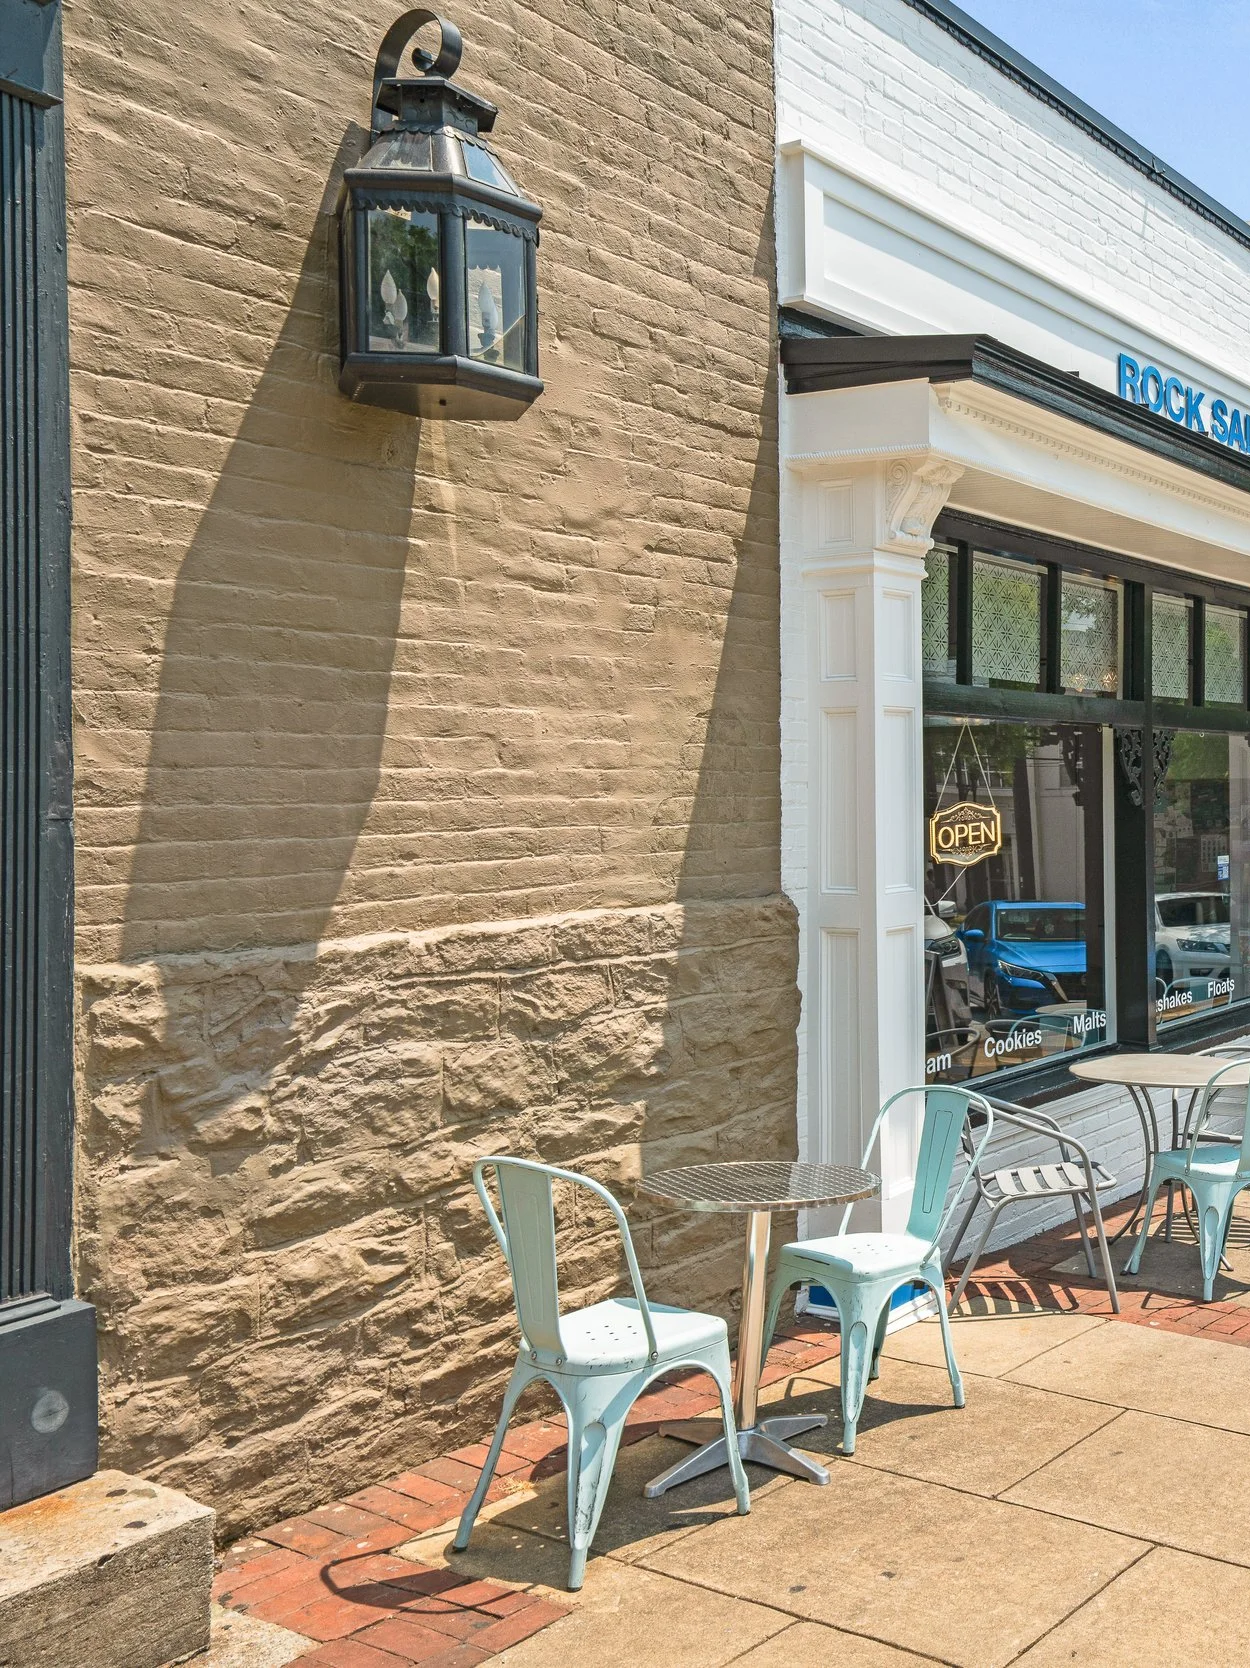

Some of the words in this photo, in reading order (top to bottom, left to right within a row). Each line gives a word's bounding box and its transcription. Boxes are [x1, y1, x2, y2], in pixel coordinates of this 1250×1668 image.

[1117, 353, 1206, 432] ROCK
[938, 820, 996, 849] OPEN
[1155, 990, 1193, 1013] shakes
[1207, 978, 1235, 999] Floats
[925, 1052, 952, 1075] am
[984, 1028, 1042, 1058] Cookies
[1073, 1011, 1107, 1035] Malts
